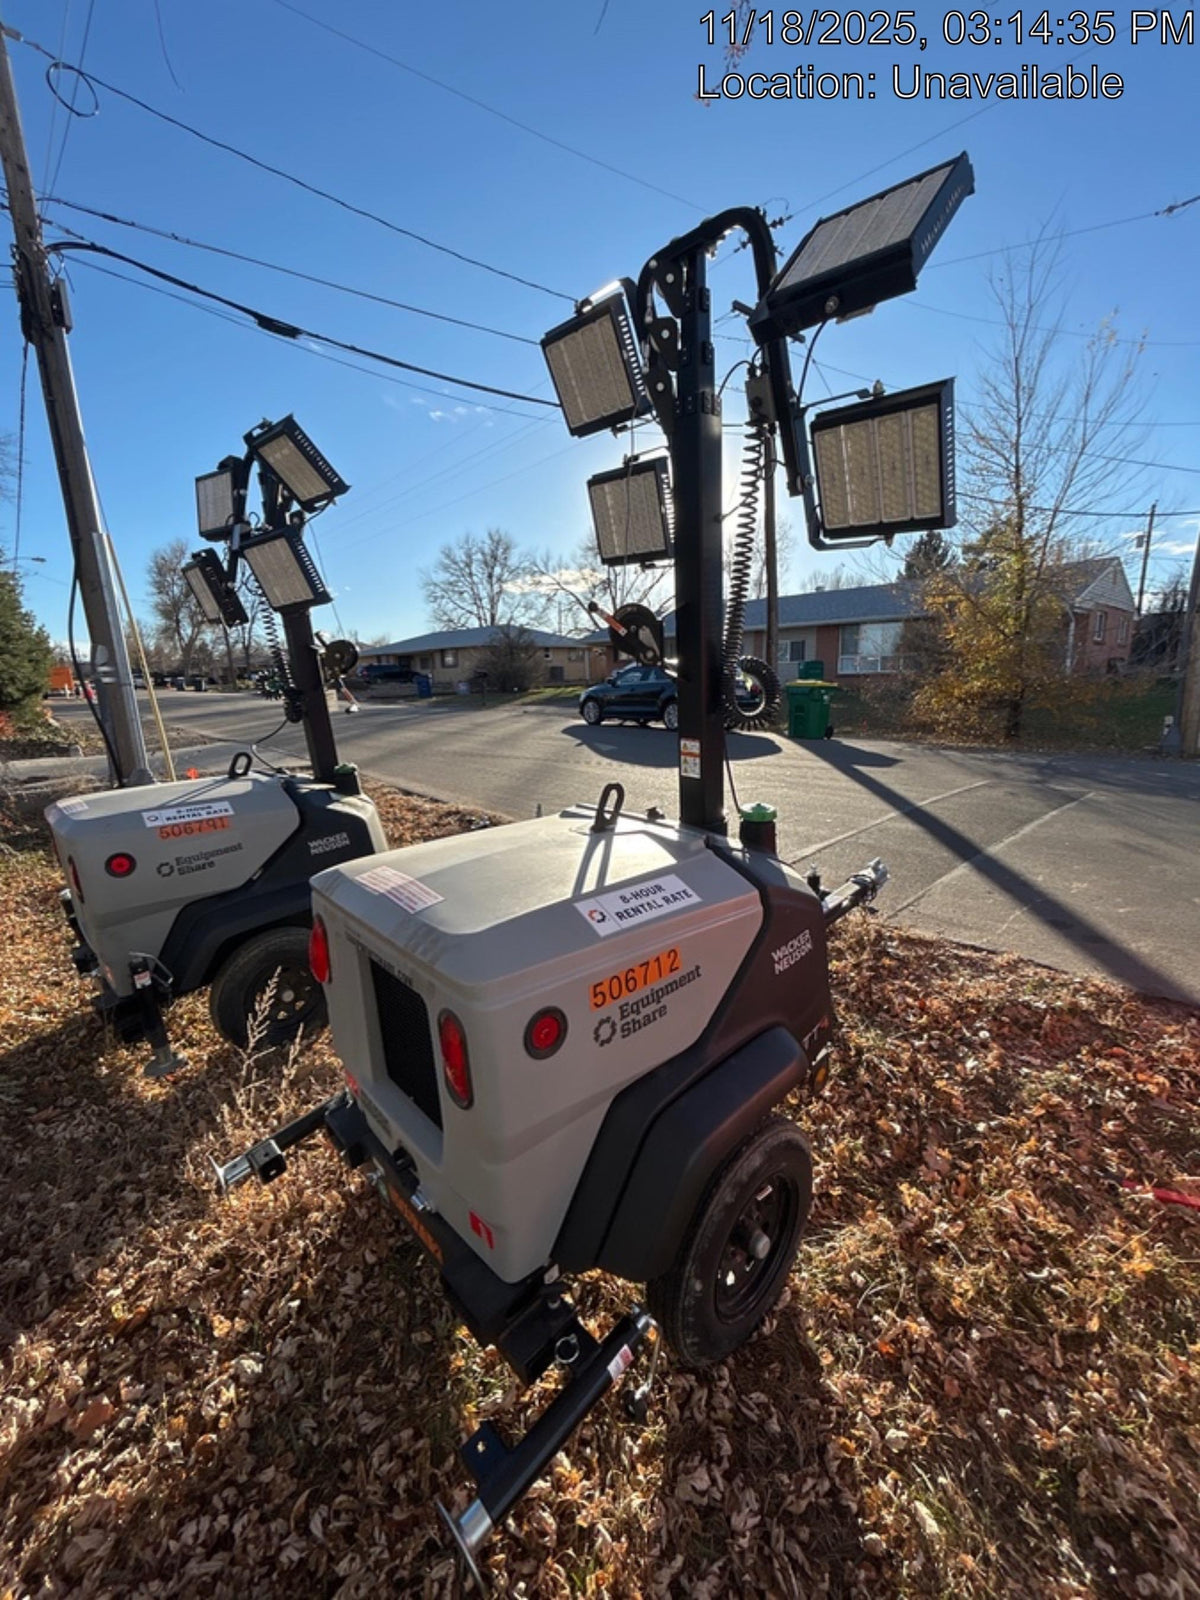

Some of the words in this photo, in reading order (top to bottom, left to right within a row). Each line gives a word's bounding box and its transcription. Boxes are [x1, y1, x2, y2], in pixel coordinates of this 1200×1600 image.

[177, 861, 216, 876] Share
[615, 900, 664, 922] RENTAL
[666, 888, 694, 906] RATE
[619, 884, 666, 904] 8-HOUR
[771, 929, 812, 961] WACKER
[774, 941, 813, 975] NEUSON
[592, 948, 681, 1009] 506712
[617, 964, 703, 1022] Equipment
[619, 1003, 669, 1039] Share
